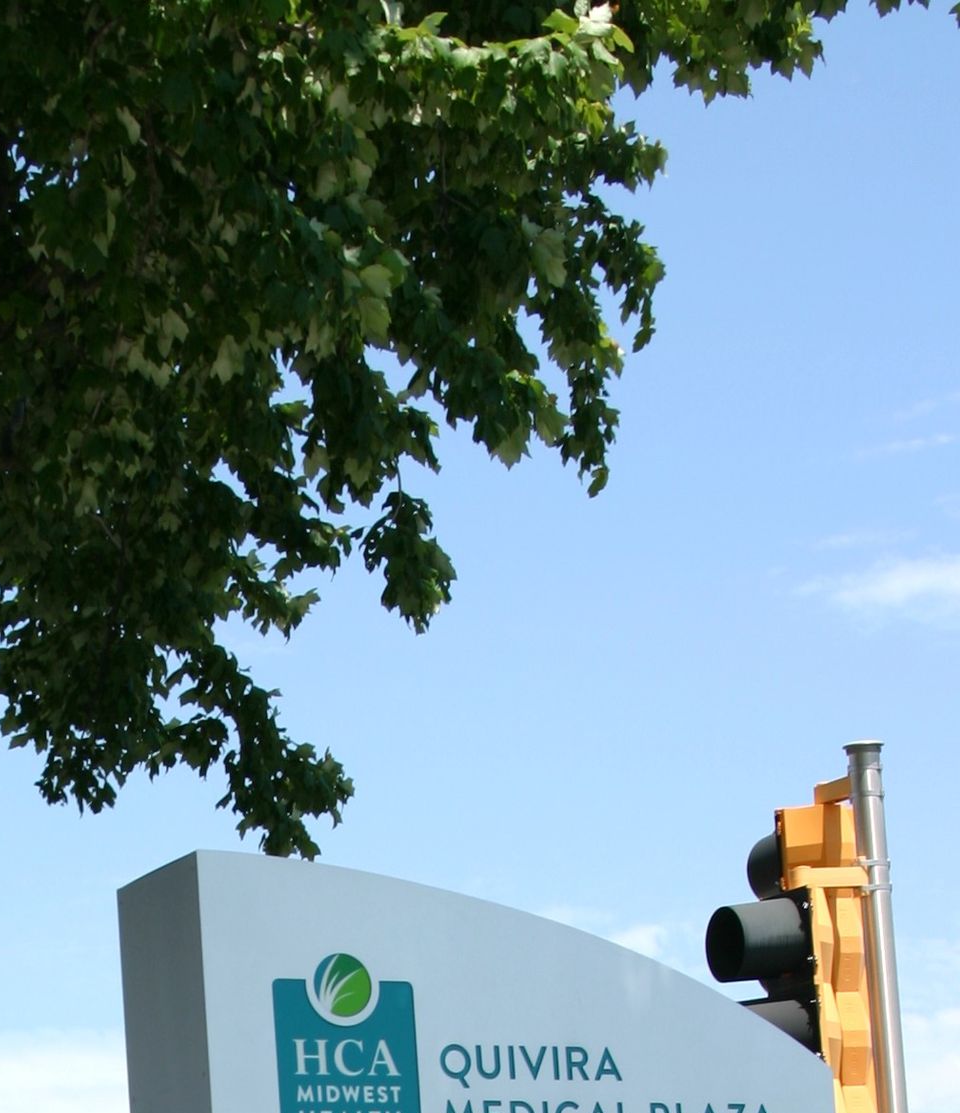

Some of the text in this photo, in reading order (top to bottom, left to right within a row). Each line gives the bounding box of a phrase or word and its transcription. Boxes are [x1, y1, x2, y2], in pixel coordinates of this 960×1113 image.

[292, 1039, 401, 1077] HCA
[440, 1043, 623, 1089] QUIVIRA
[297, 1085, 401, 1104] MIDWEST
